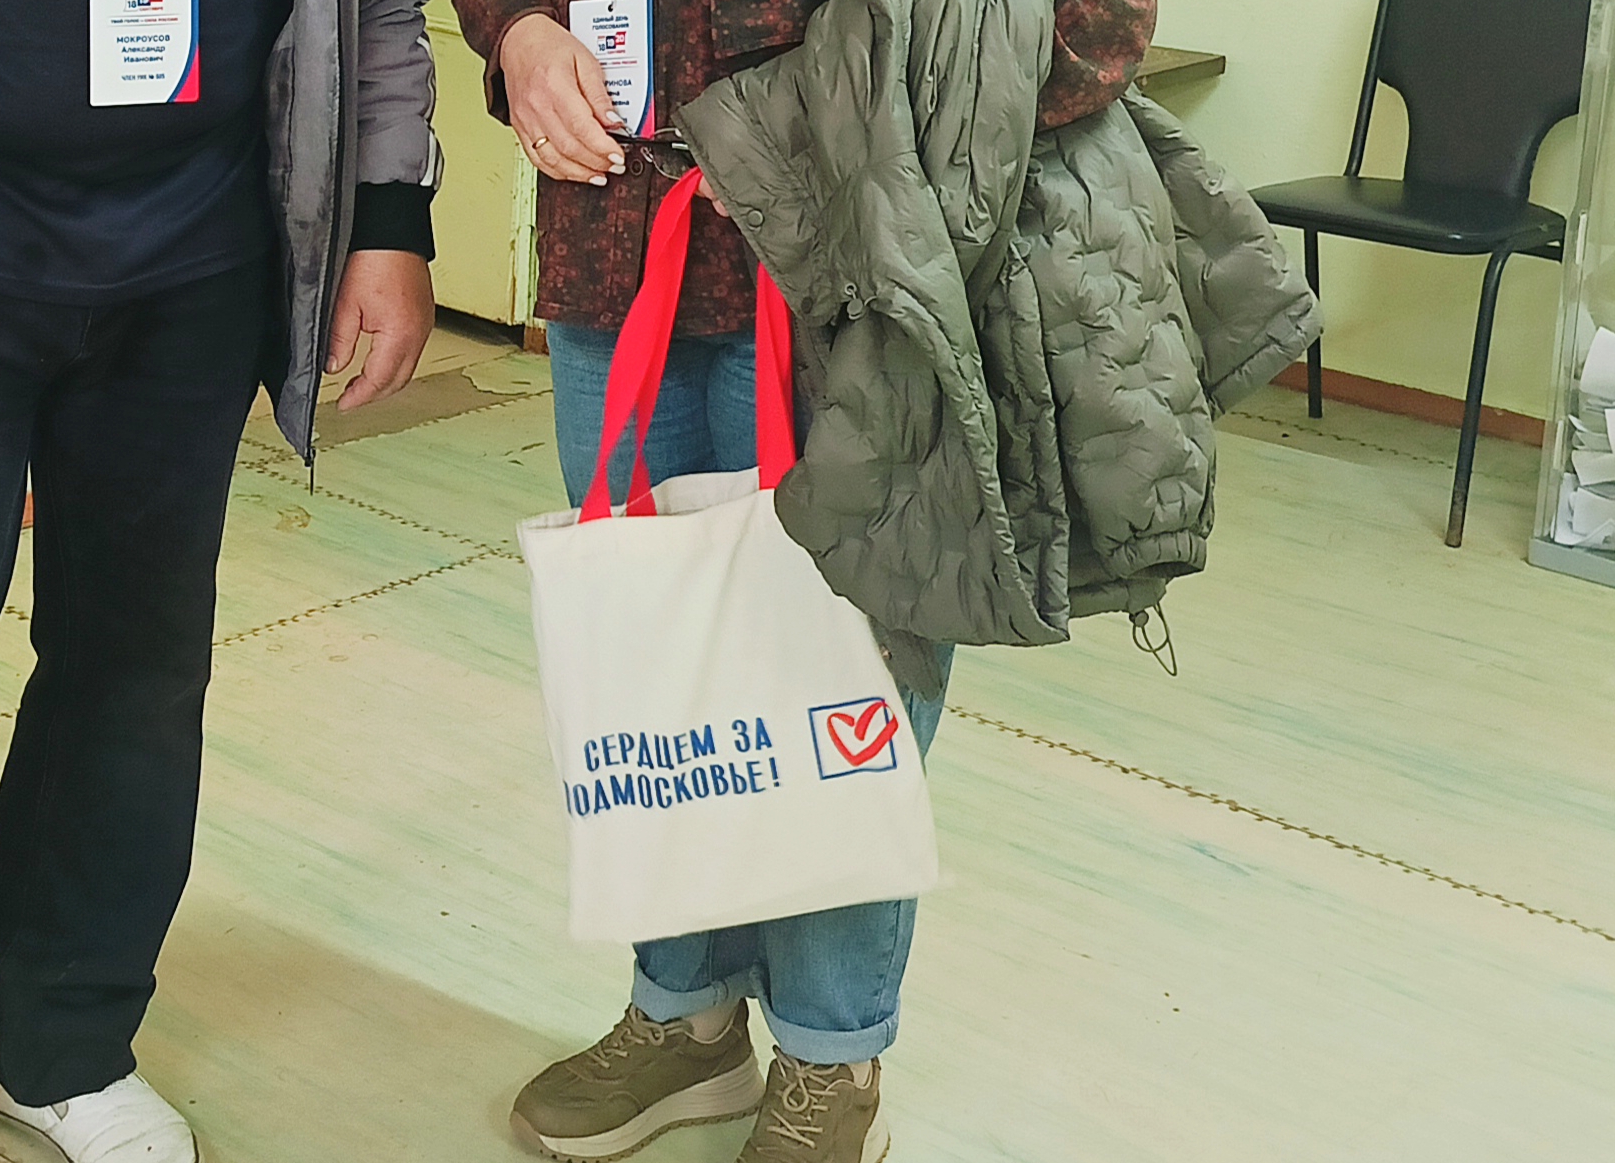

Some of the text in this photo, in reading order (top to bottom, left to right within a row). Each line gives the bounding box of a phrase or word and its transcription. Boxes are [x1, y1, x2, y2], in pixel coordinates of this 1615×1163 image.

[127, 0, 137, 9] 18
[592, 15, 614, 24] ЕДИНЫЙ
[592, 22, 630, 31] ГОЛОСОВАНИЯ
[116, 34, 171, 44] МОКРОУСОВ
[121, 45, 166, 53] Александр
[124, 55, 164, 63] Иванович
[584, 717, 773, 772] СЕРДЦЕМ ЗА
